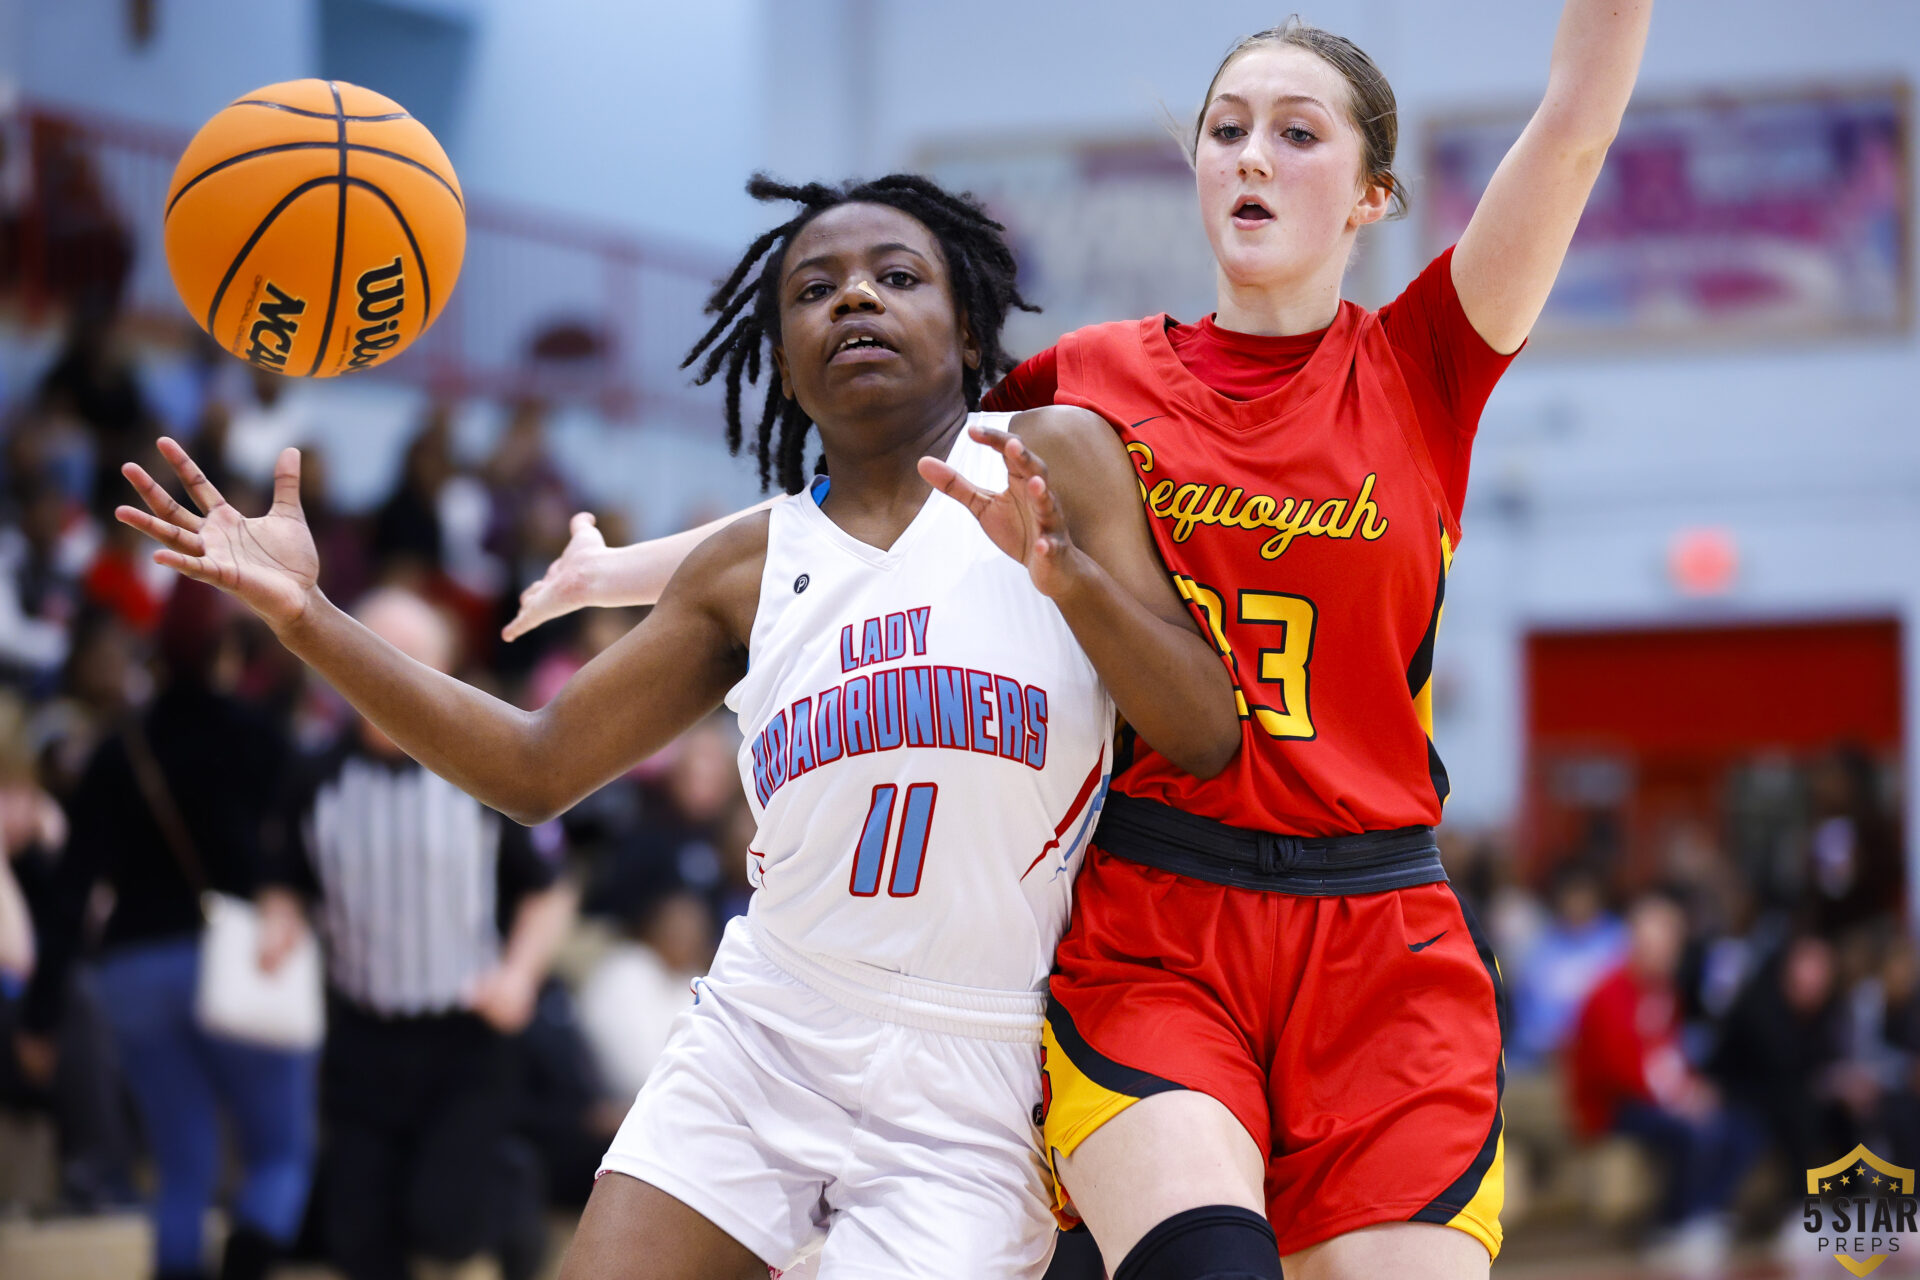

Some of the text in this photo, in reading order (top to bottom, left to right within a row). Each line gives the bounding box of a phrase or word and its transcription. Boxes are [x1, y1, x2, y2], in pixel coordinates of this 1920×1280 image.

[840, 606, 931, 673] LADY
[751, 665, 1048, 811] ROADRUNNERS
[849, 782, 938, 897] 11
